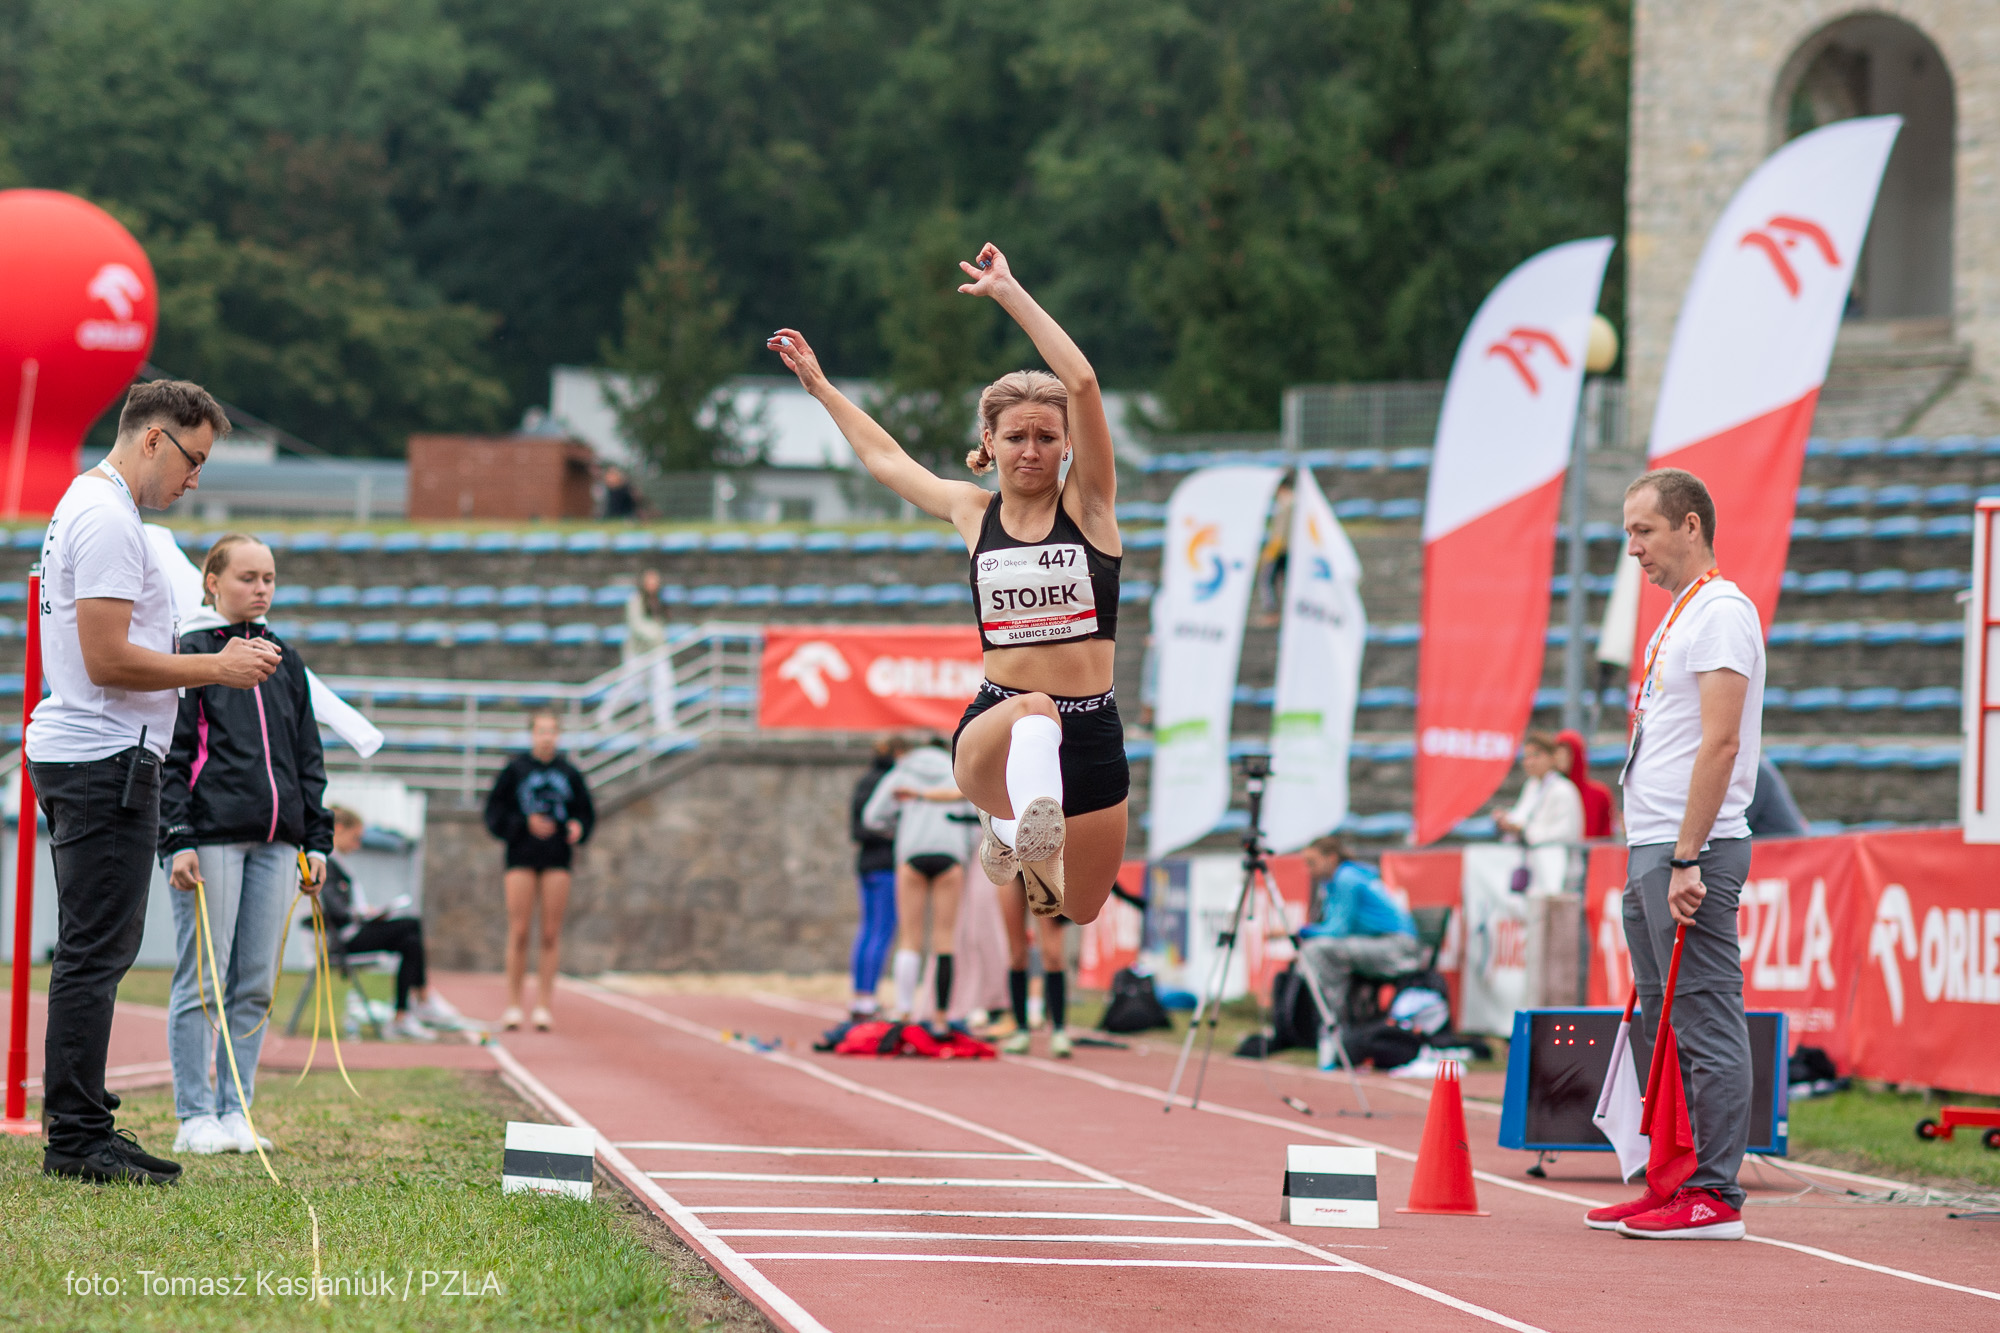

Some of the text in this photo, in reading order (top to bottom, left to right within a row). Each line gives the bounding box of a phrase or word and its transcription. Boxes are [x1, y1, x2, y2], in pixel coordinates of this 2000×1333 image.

[1003, 559, 1028, 568] Okęcie
[1038, 549, 1077, 569] 447
[991, 583, 1079, 611] STOJEK
[1008, 625, 1072, 640] SŁUBICE 2023
